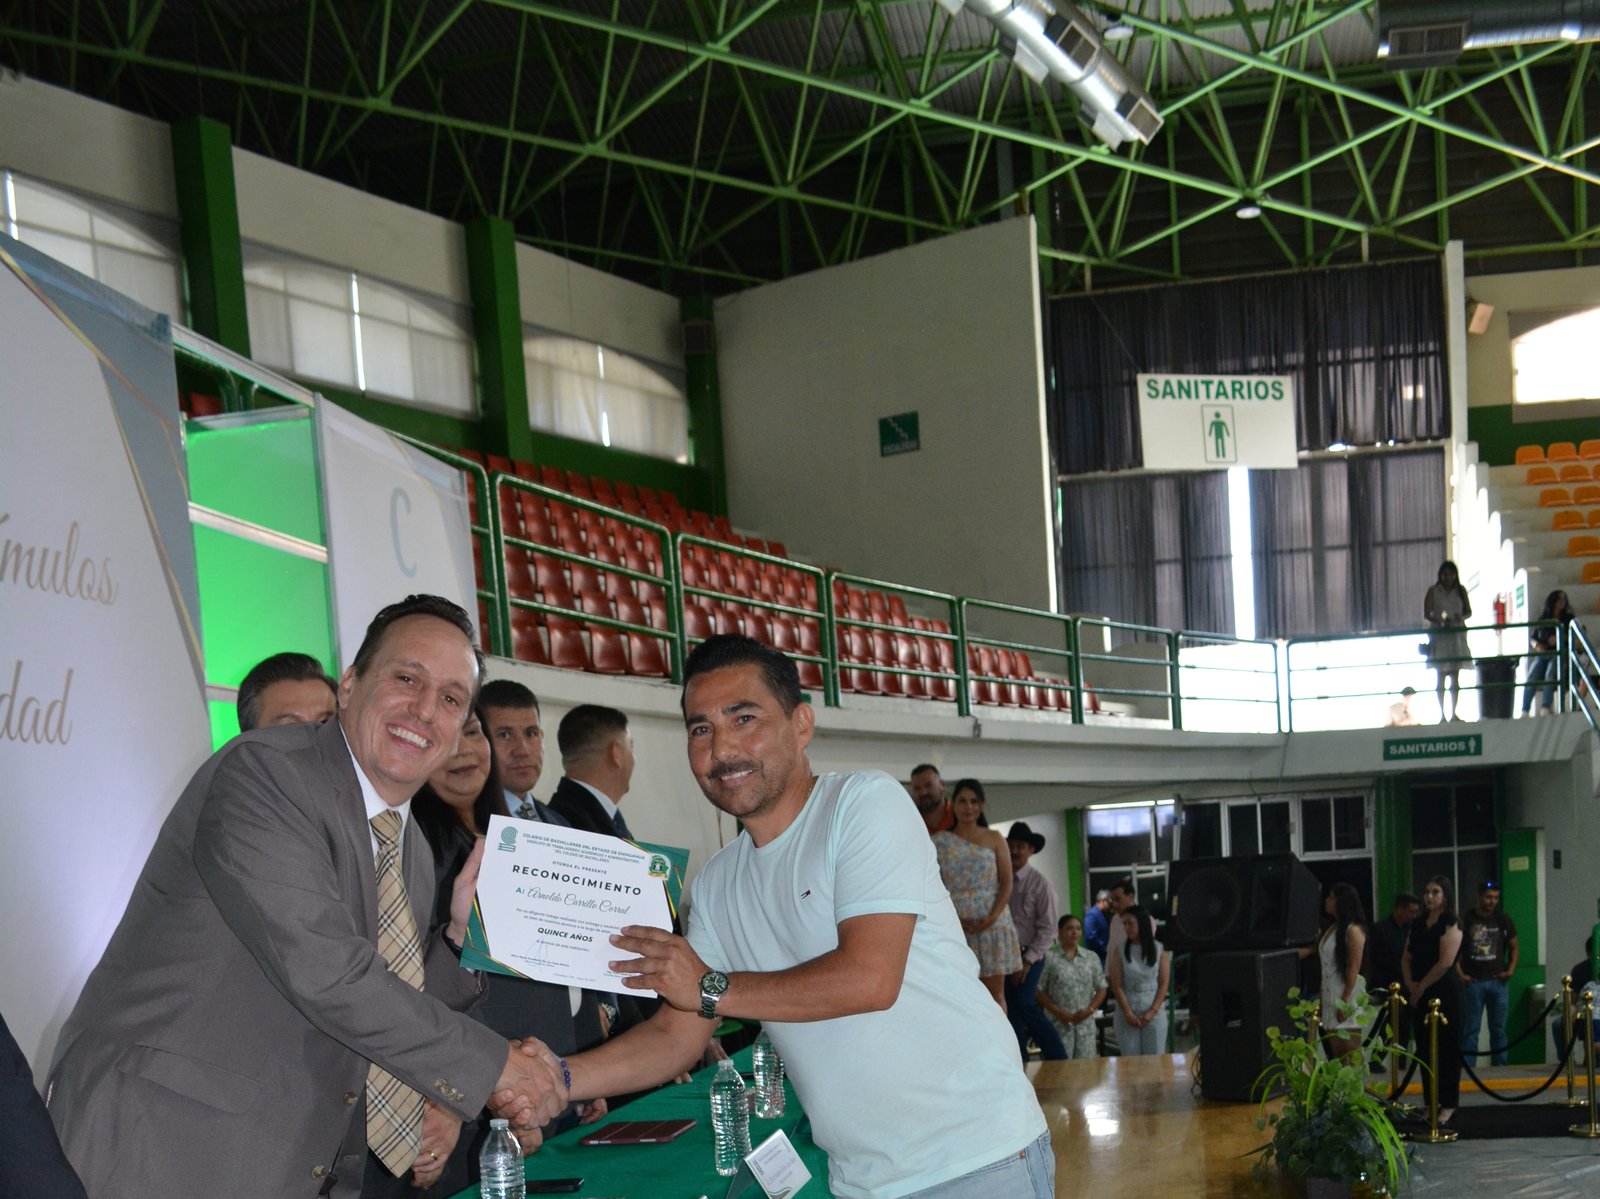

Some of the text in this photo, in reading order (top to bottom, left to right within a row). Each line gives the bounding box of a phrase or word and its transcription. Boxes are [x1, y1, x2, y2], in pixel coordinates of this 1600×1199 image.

[1146, 378, 1285, 401] SANITARIOS
[1389, 741, 1466, 755] SANITARIOS
[523, 832, 543, 841] COLEGIO
[550, 838, 582, 848] BACHILLERES
[591, 846, 611, 854] ESTADO
[617, 851, 645, 860] CHIHUAHUA
[552, 860, 573, 868] OTORGA
[582, 866, 607, 875] PRESENTE
[512, 864, 642, 896] RECONOCIMIENTO
[527, 886, 562, 903] Arnoldo
[563, 893, 598, 910] Carrillo
[598, 899, 631, 915] Corral
[537, 927, 594, 943] QUINCE AÑOS
